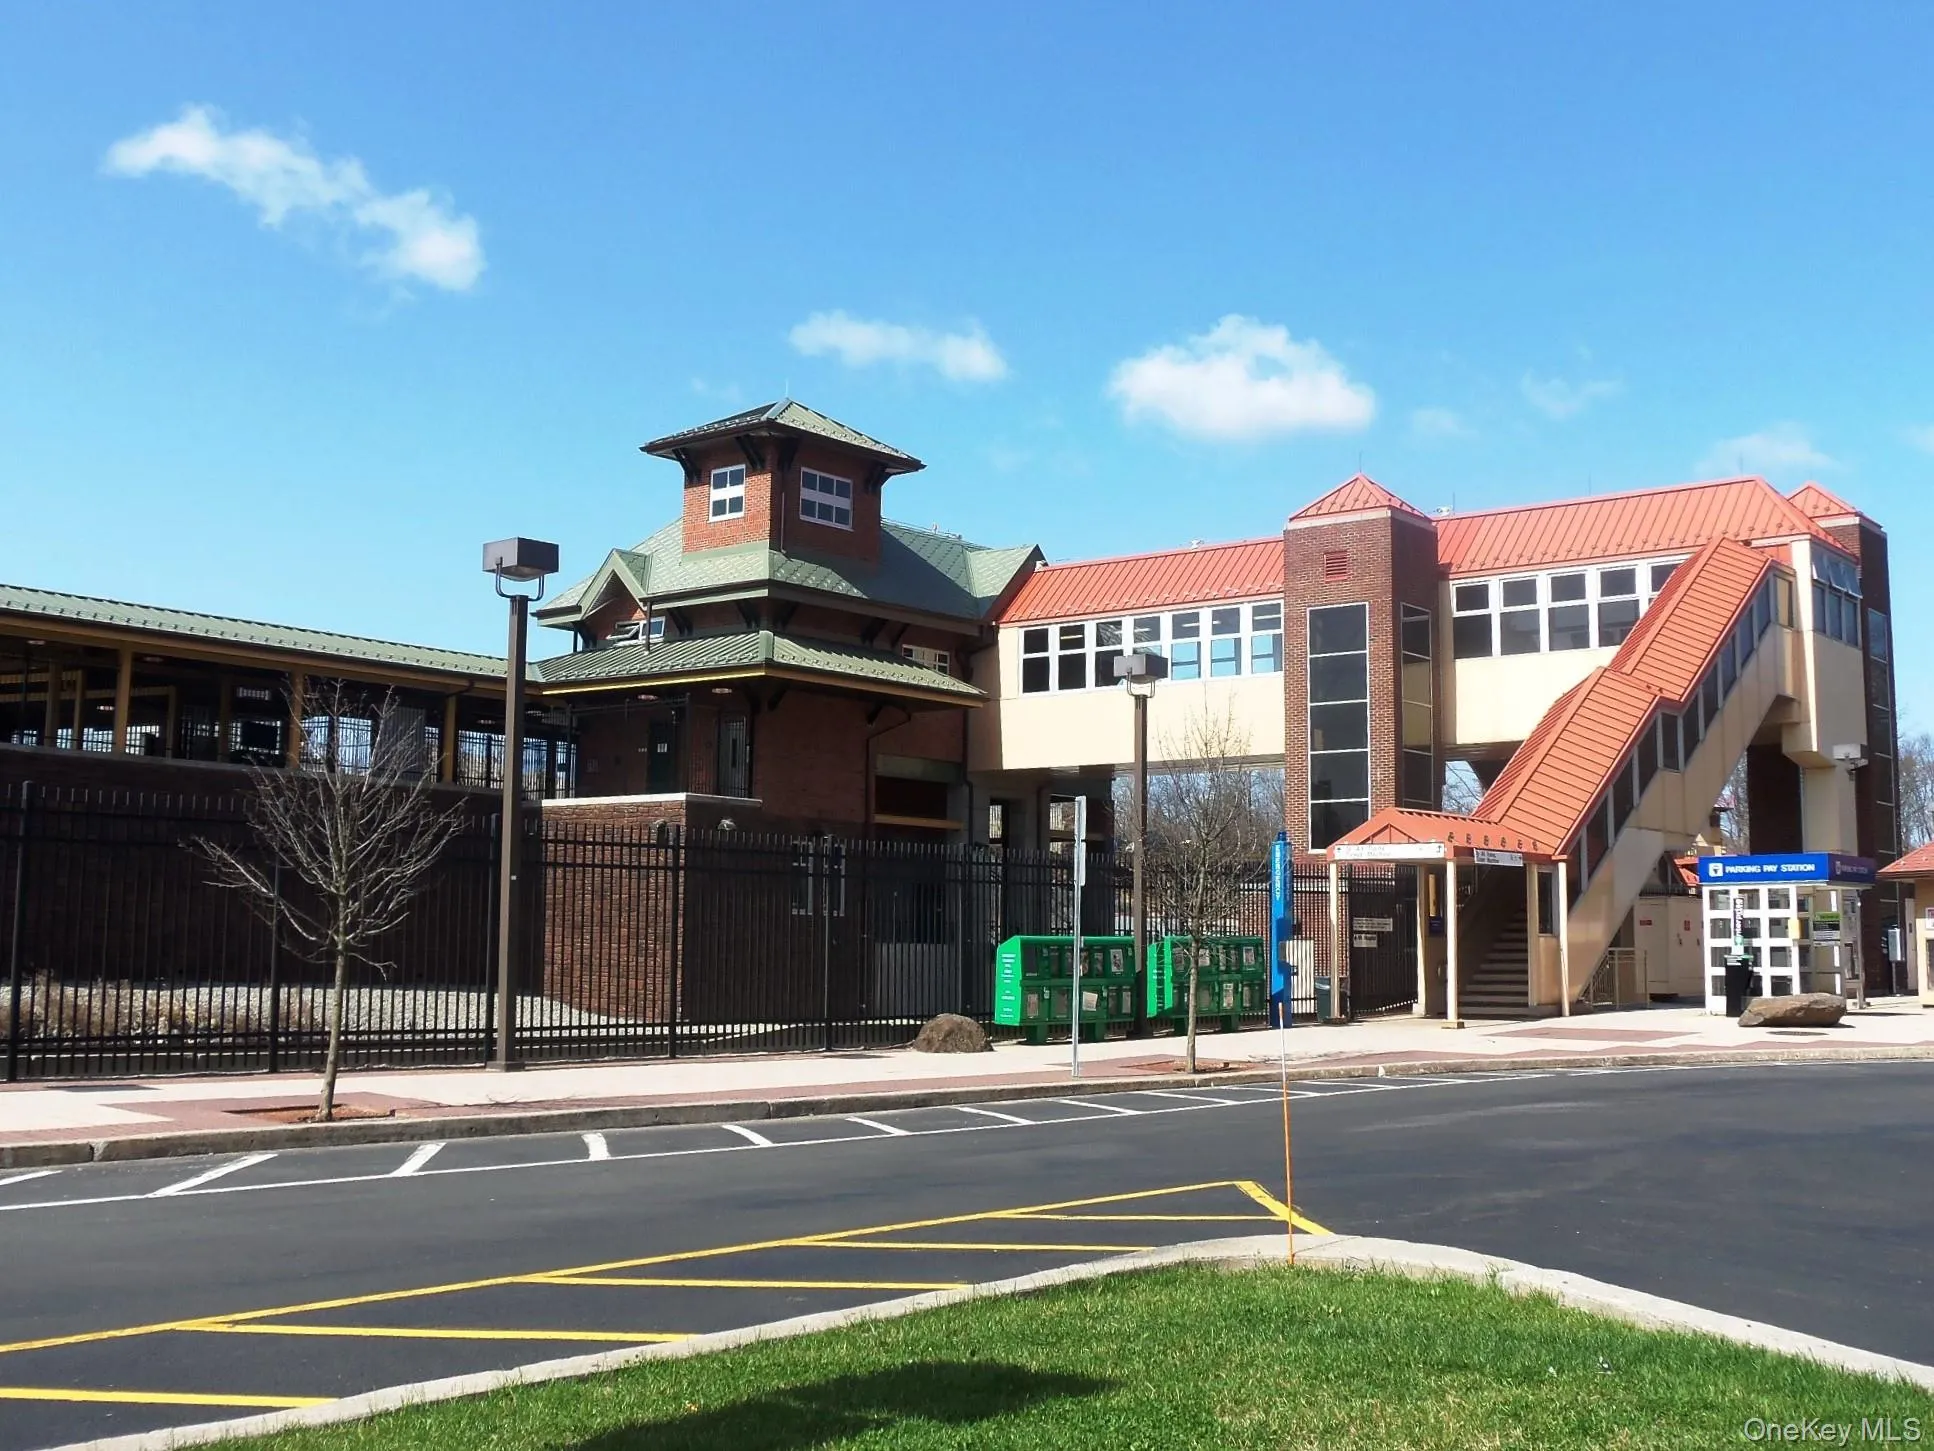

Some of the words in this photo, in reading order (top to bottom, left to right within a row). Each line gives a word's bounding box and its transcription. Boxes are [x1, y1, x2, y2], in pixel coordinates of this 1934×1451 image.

[1725, 865, 1761, 873] PARKING
[1763, 864, 1778, 872] PAY
[1781, 863, 1815, 872] STATION
